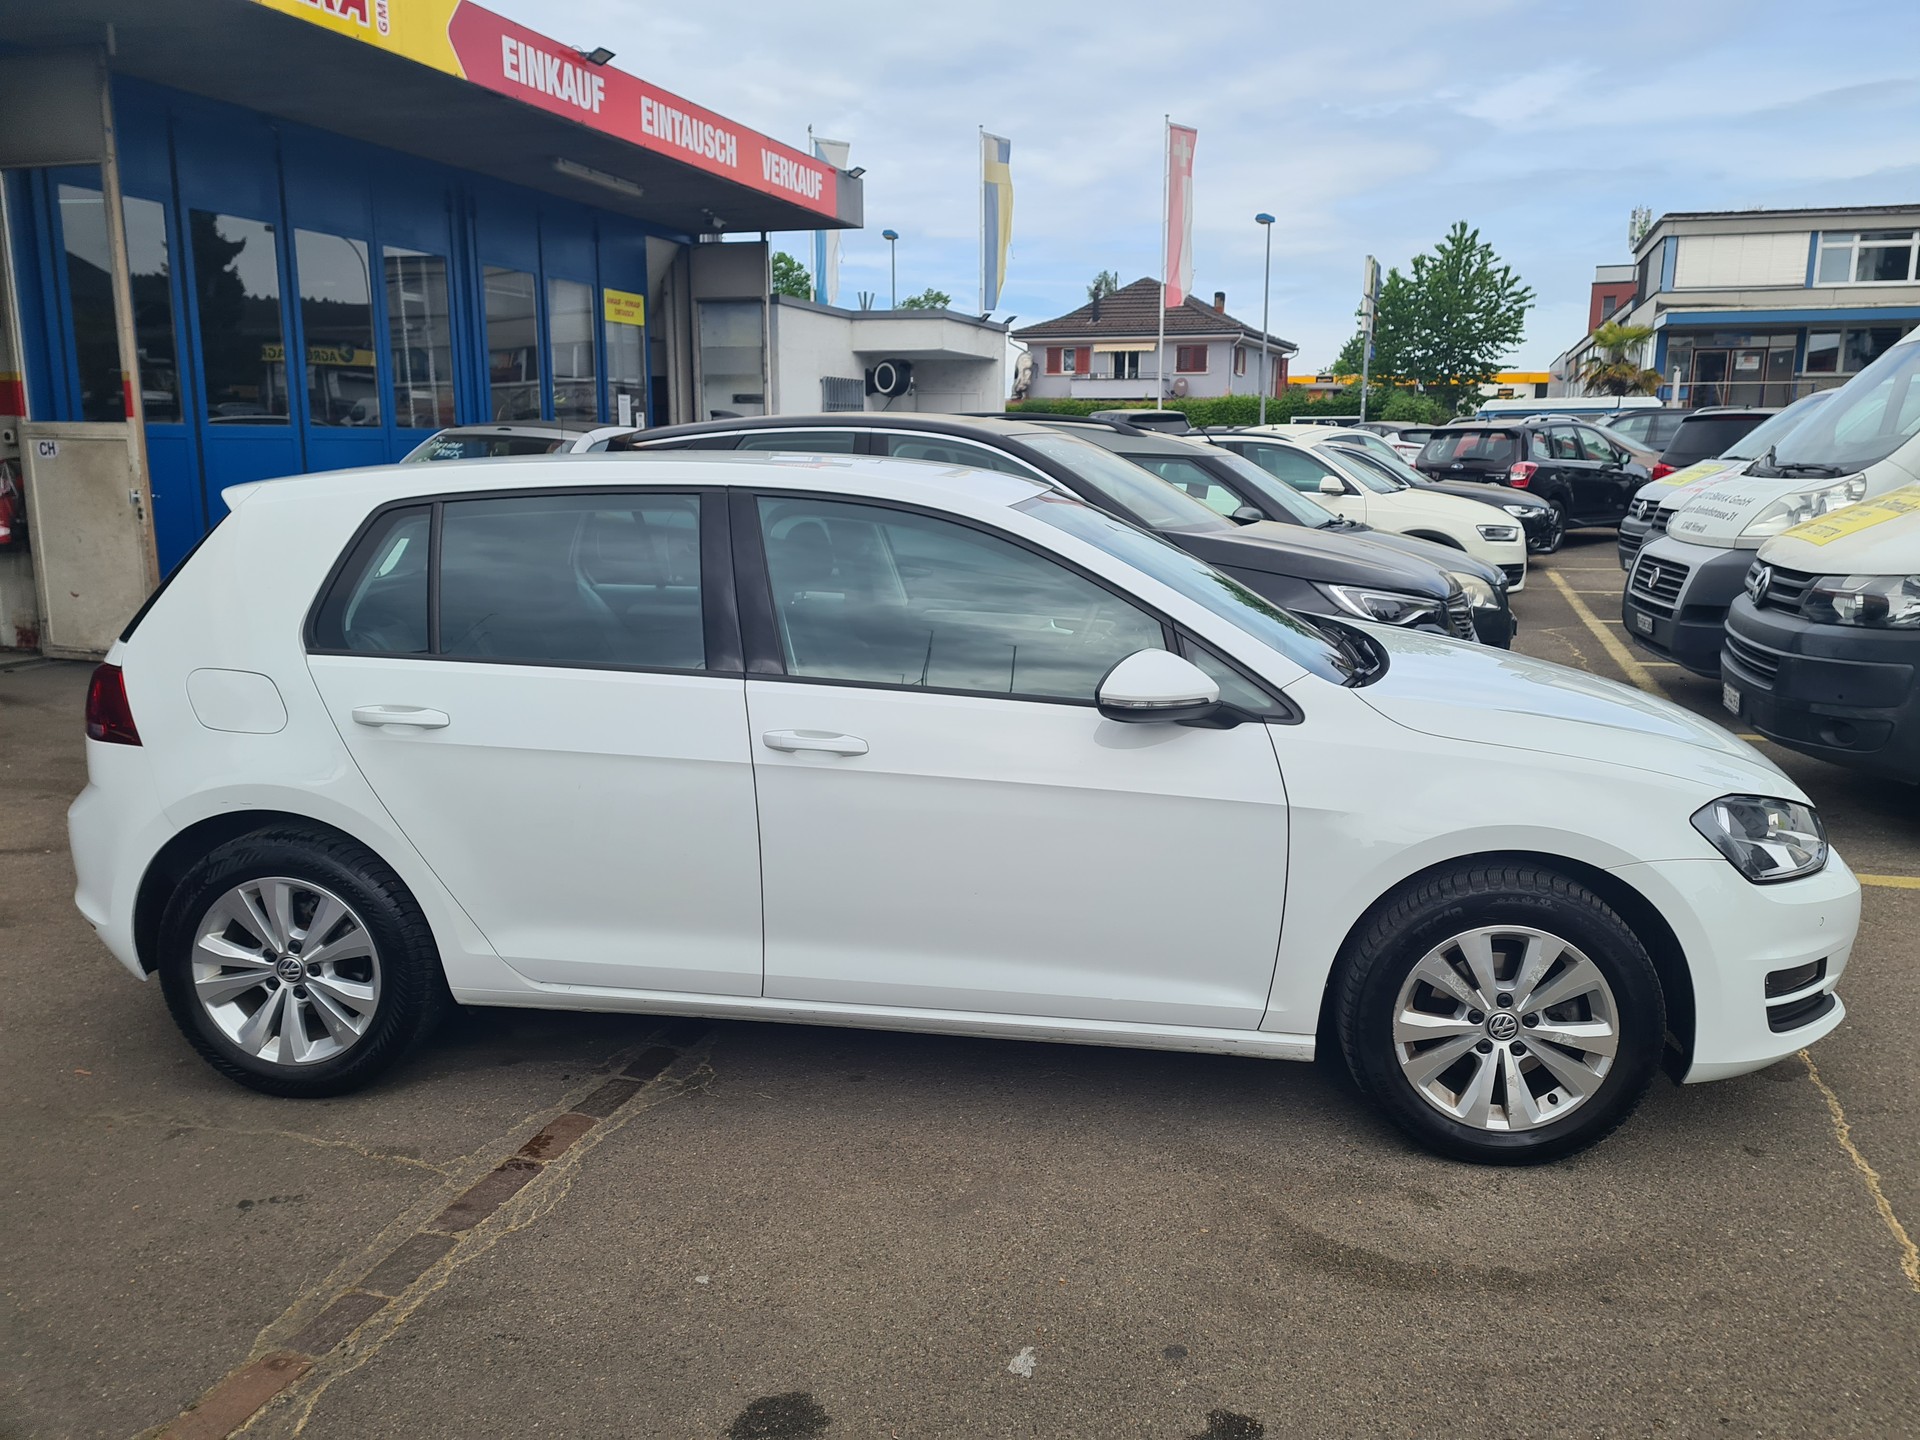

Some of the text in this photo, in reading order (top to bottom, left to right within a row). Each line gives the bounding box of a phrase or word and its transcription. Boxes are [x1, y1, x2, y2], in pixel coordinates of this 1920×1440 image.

[501, 34, 823, 201] EINKAUF EINTAUSCH VERKAUF
[39, 441, 56, 456] CH
